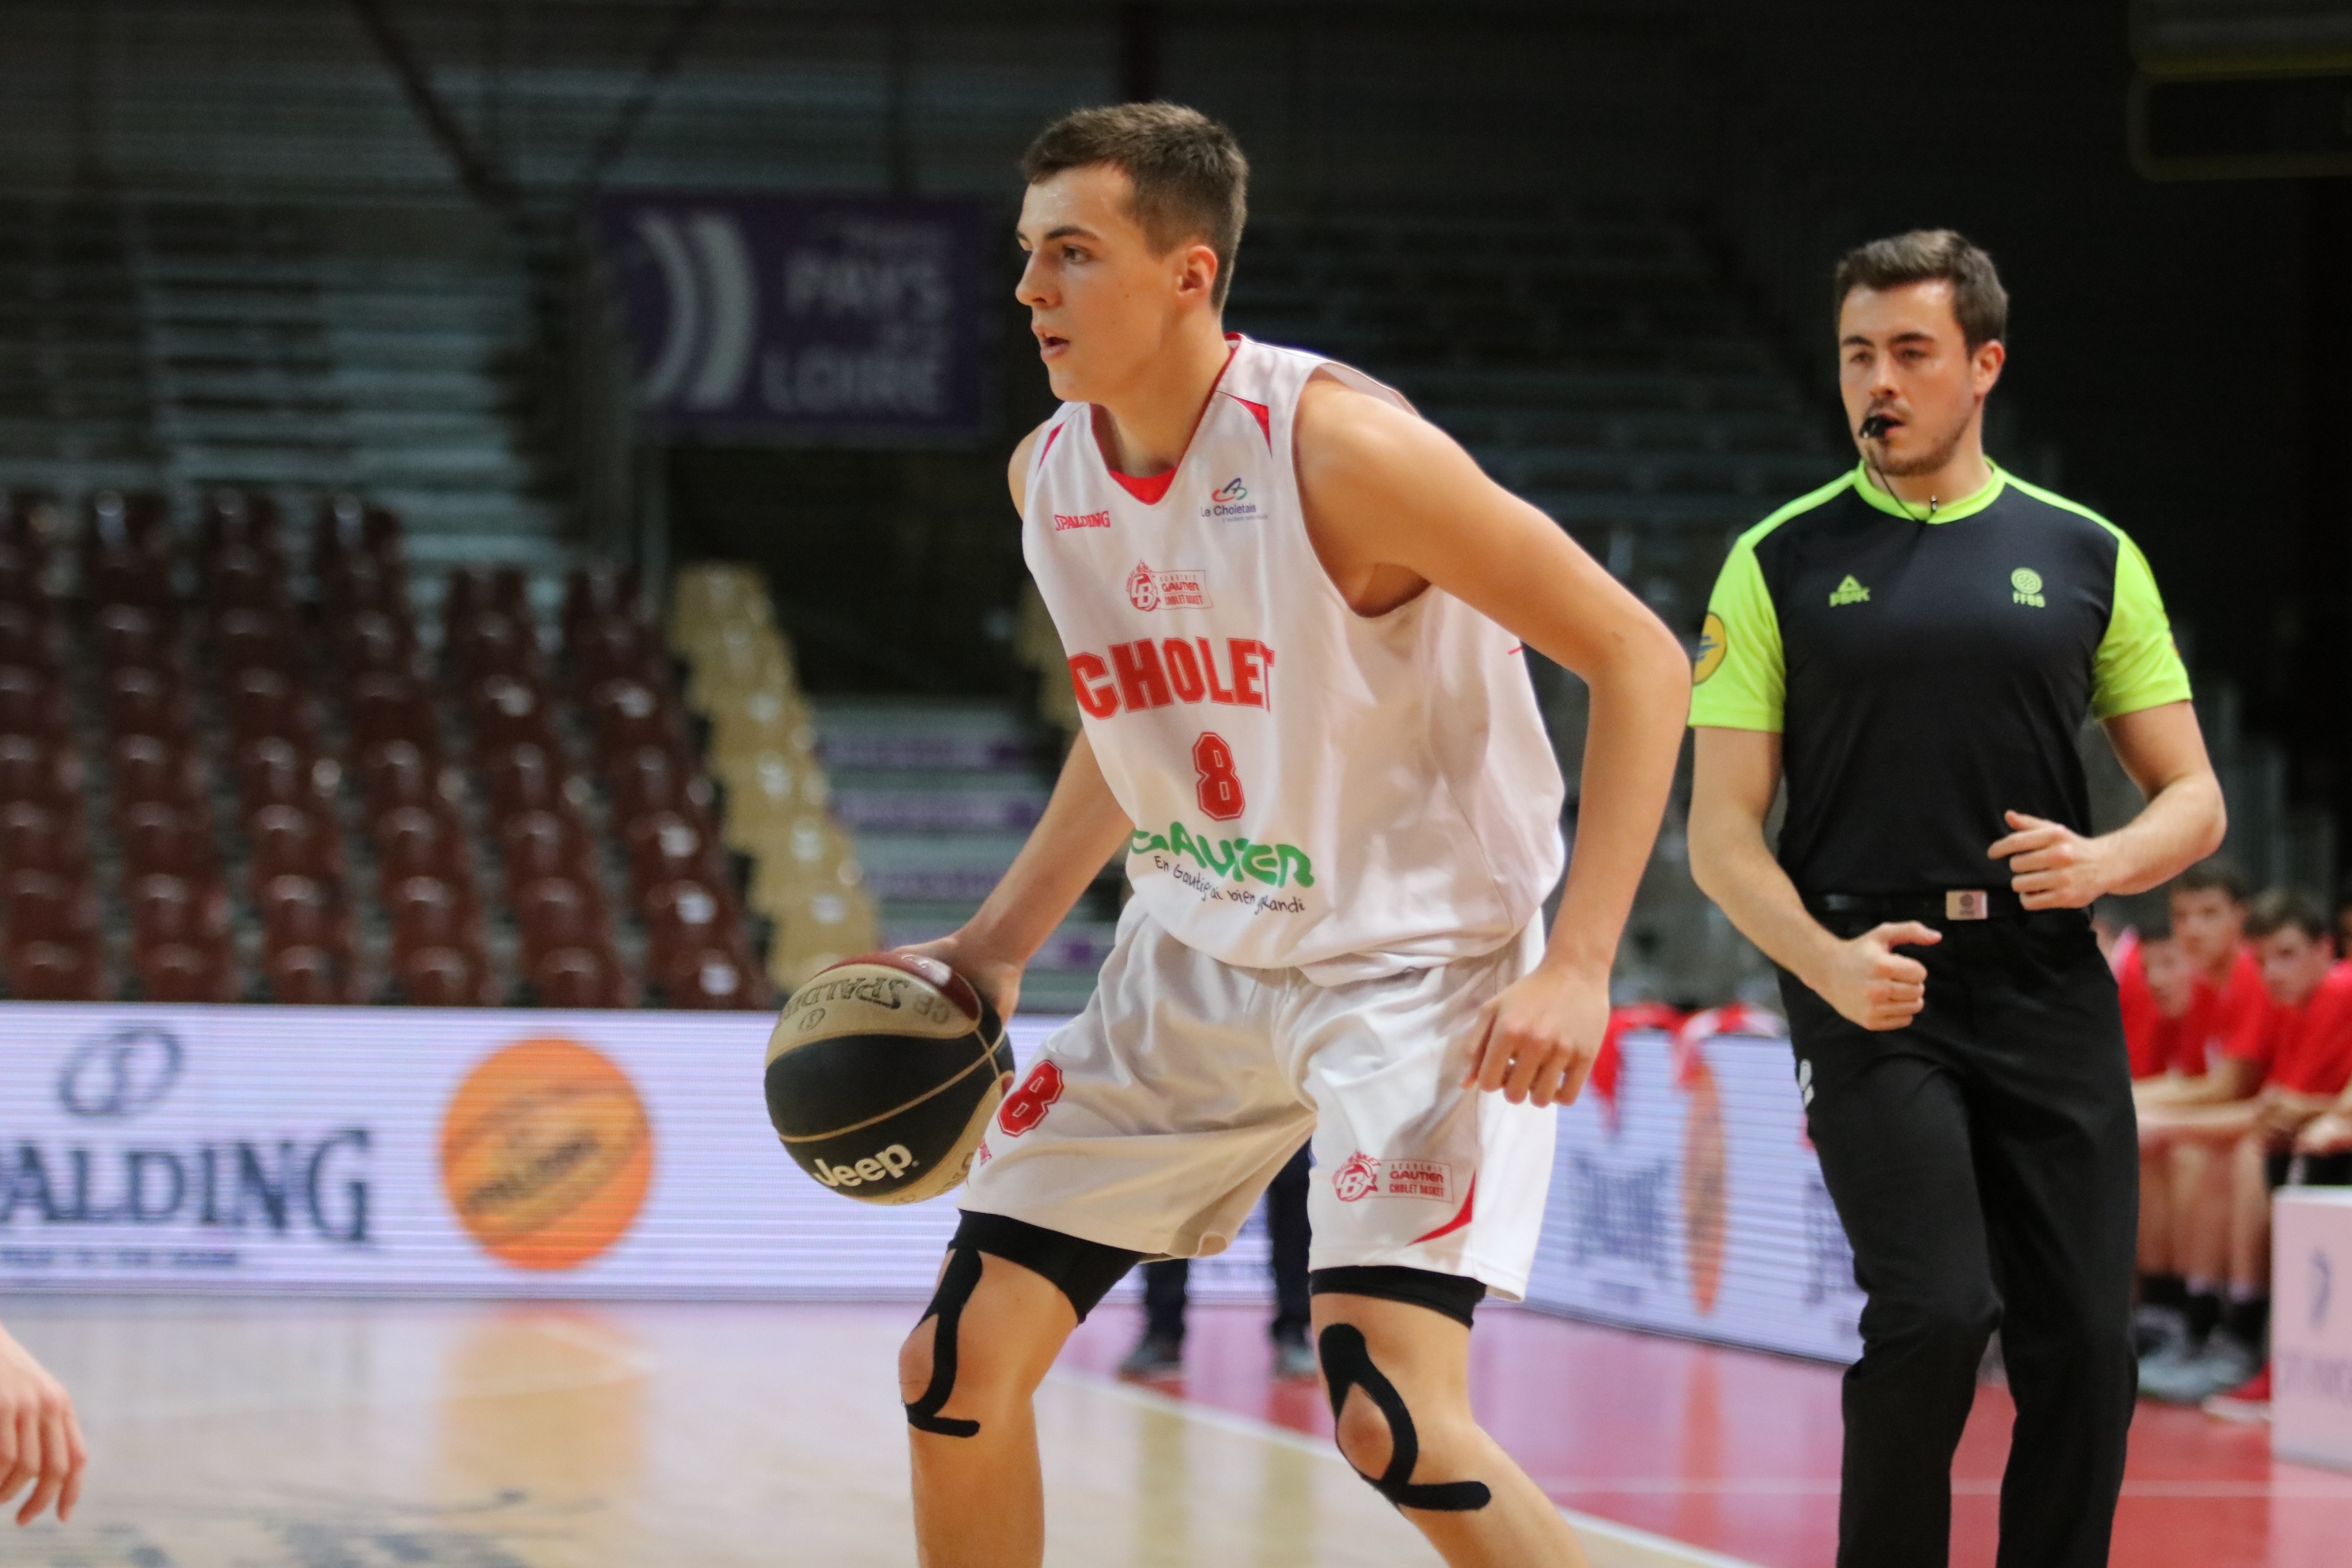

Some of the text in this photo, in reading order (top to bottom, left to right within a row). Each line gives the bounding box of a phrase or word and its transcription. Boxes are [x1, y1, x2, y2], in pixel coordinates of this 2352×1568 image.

[1054, 510, 1111, 531] SPALDING
[1214, 503, 1257, 516] Choletais
[1162, 582, 1200, 592] GAUTIER
[2012, 591, 2046, 608] FFBB
[1192, 731, 1246, 822] 8
[1131, 821, 1315, 888] GAUIER
[1153, 855, 1169, 870] En
[1227, 888, 1256, 905] bien
[997, 1059, 1065, 1138] 8
[813, 1144, 913, 1187] Jeep
[1389, 1170, 1444, 1184] GAUTIER
[0, 1128, 368, 1241] ALDING
[1389, 1183, 1444, 1197] CHOLET BASKET
